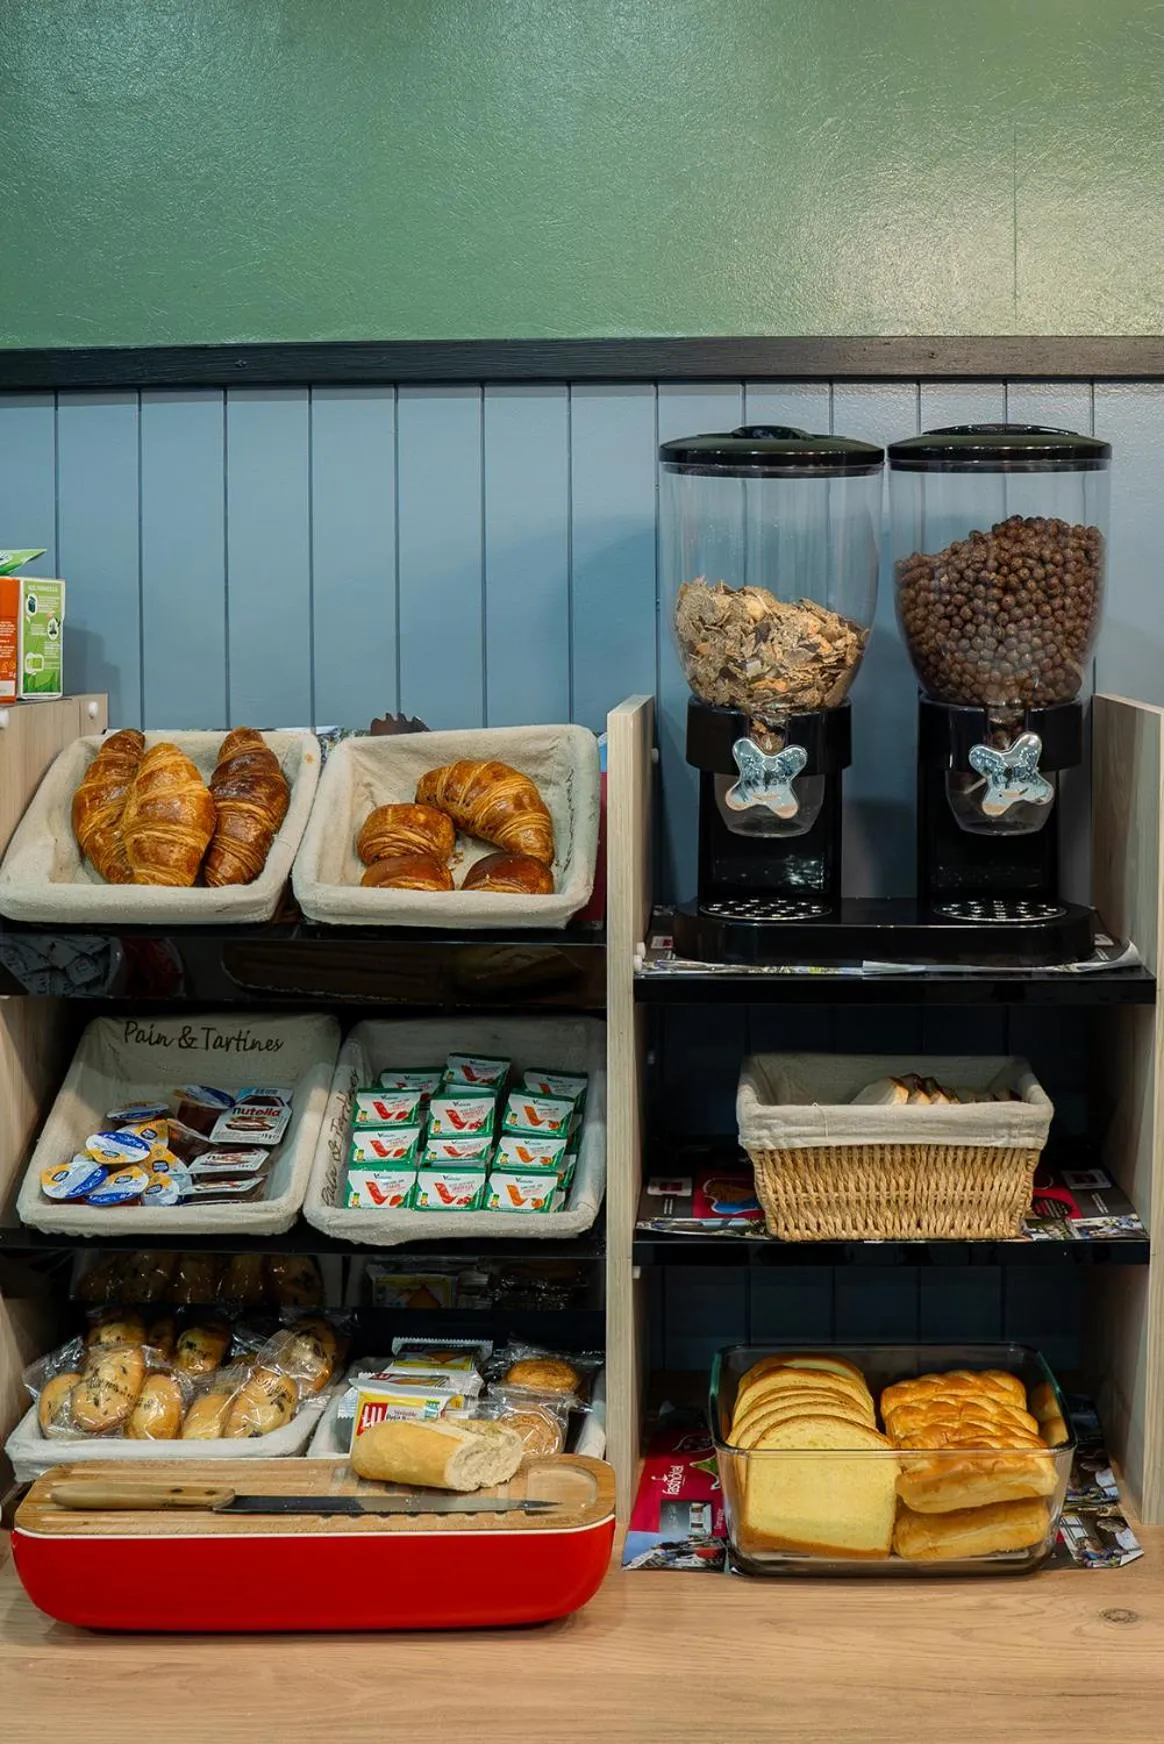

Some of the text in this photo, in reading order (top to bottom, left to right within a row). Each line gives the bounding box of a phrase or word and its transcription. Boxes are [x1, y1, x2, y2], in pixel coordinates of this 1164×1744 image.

[124, 1020, 284, 1052] Pain & Tartines
[232, 1107, 281, 1117] nutella
